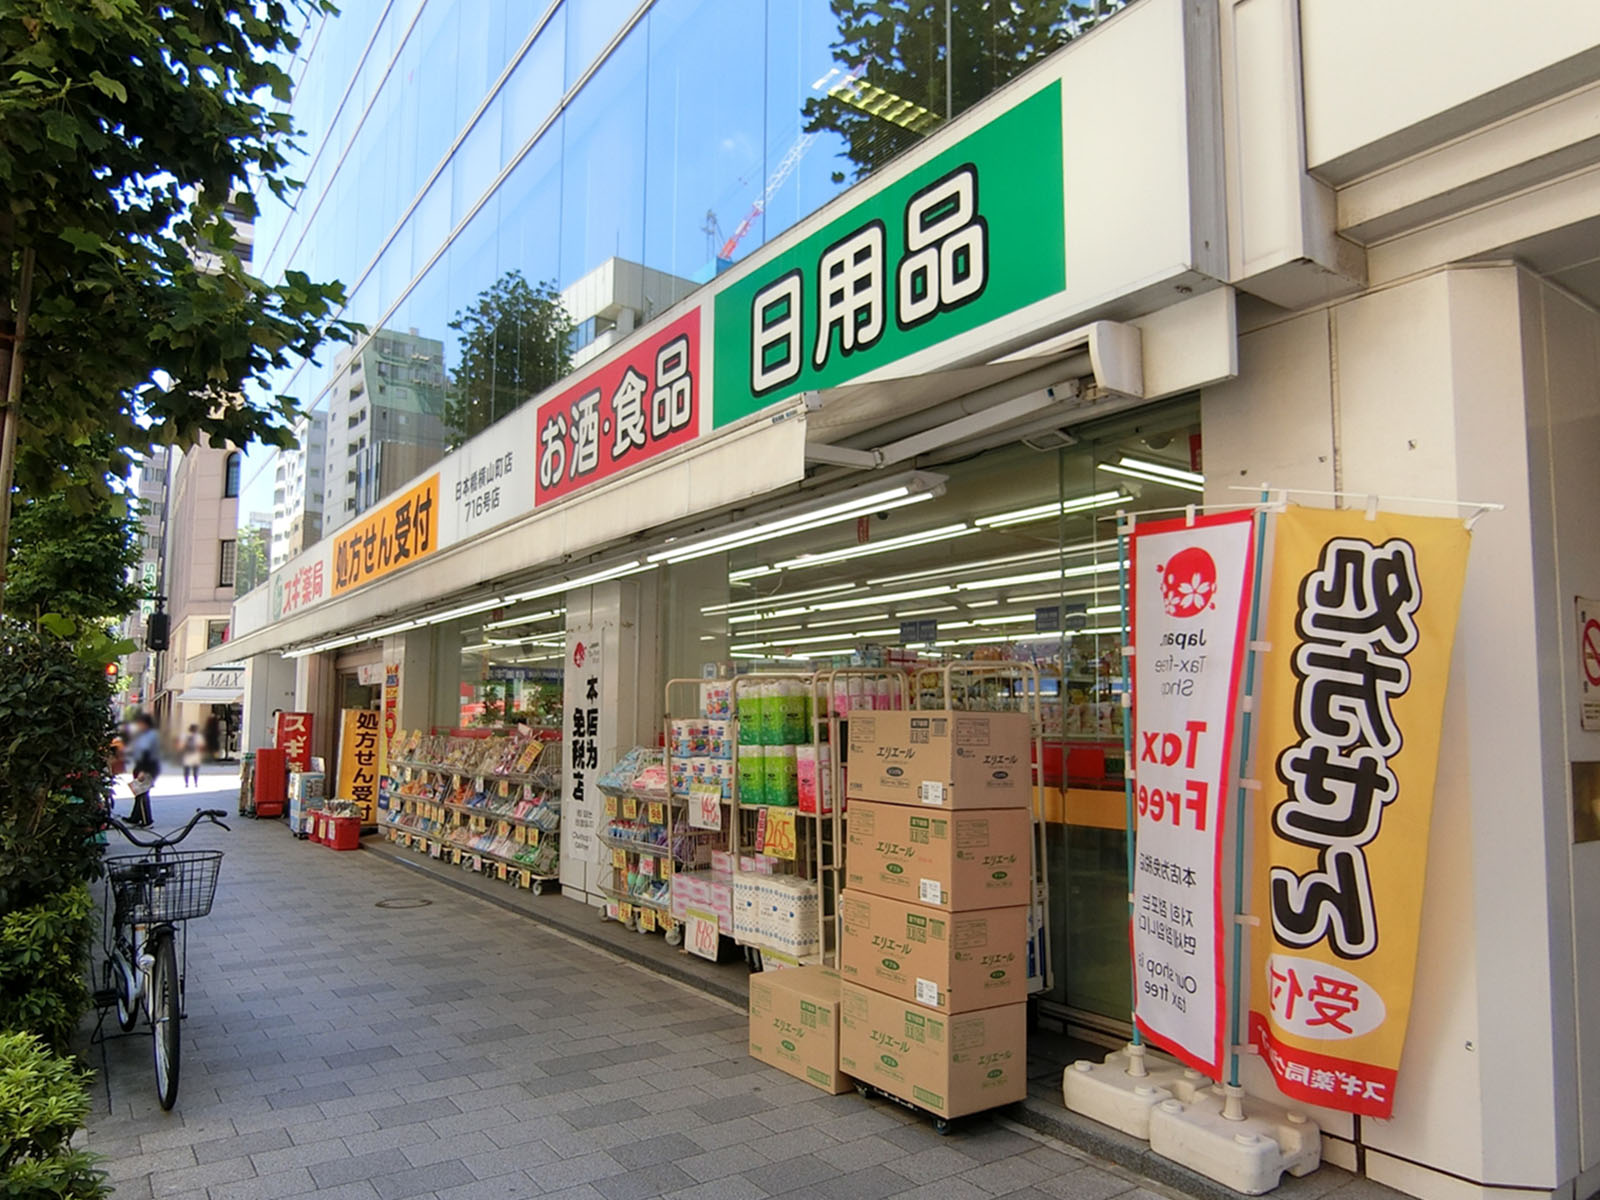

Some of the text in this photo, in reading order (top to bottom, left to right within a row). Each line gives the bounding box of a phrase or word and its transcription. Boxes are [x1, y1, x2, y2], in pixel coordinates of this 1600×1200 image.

[751, 162, 989, 398] 日用品
[539, 333, 693, 491] お酒・食品
[456, 451, 513, 502] 日本橋横山町店
[465, 487, 500, 522] 716号店
[336, 488, 432, 590] 処方せん受付
[282, 560, 323, 615] スギ薬局
[207, 672, 245, 687] MAX
[876, 746, 916, 760] エリエール
[983, 754, 1018, 765] エリエール
[876, 841, 915, 857] エリエール
[982, 854, 1017, 865] エリエール
[872, 935, 911, 955] エリエール
[980, 952, 1015, 965] エリエール
[773, 1017, 806, 1038] エリエール
[870, 1030, 910, 1053] エリエール
